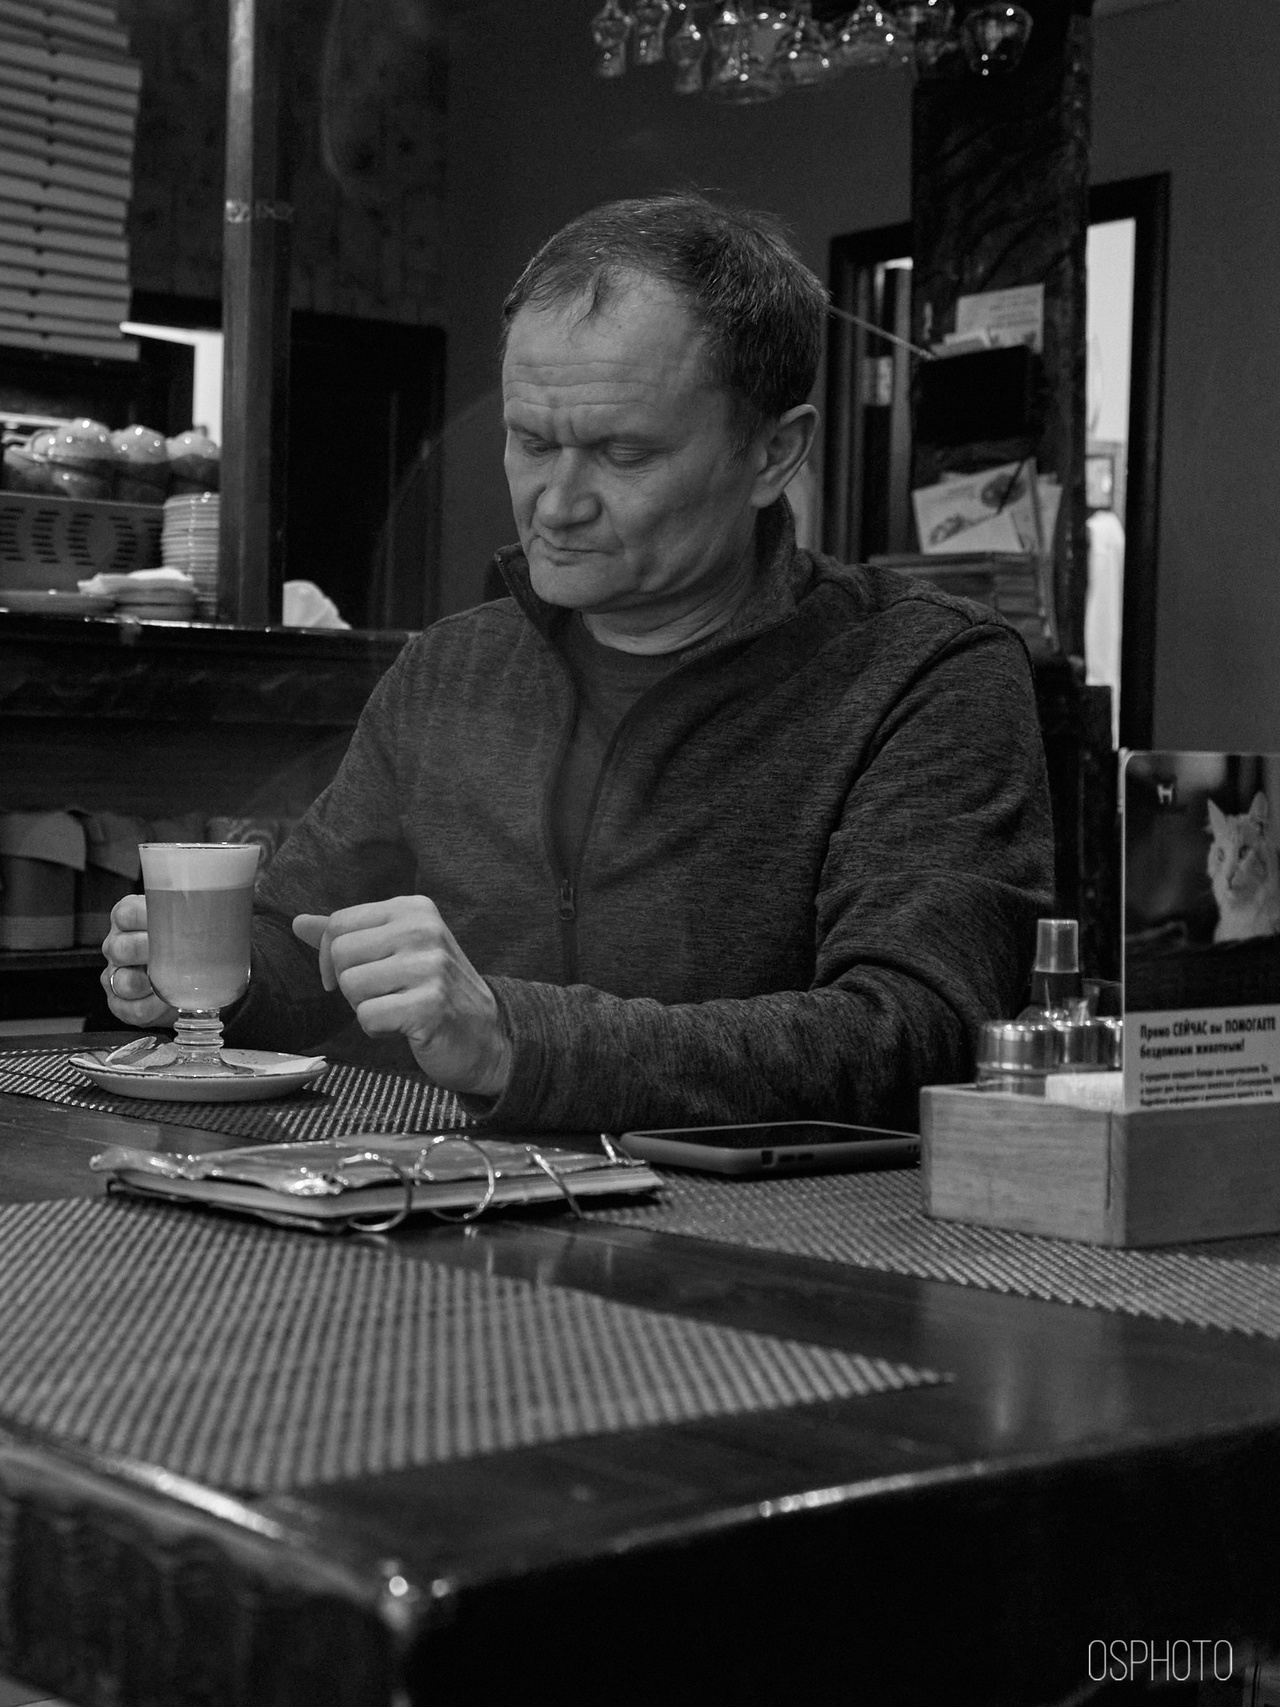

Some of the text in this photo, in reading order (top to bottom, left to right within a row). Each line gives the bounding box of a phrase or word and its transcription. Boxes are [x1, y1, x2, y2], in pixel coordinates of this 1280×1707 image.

[1140, 1016, 1276, 1041] Прямо СЕЙЧАС вы ПОМОГАЕТЕ
[1140, 1039, 1245, 1060] бездомным животным!
